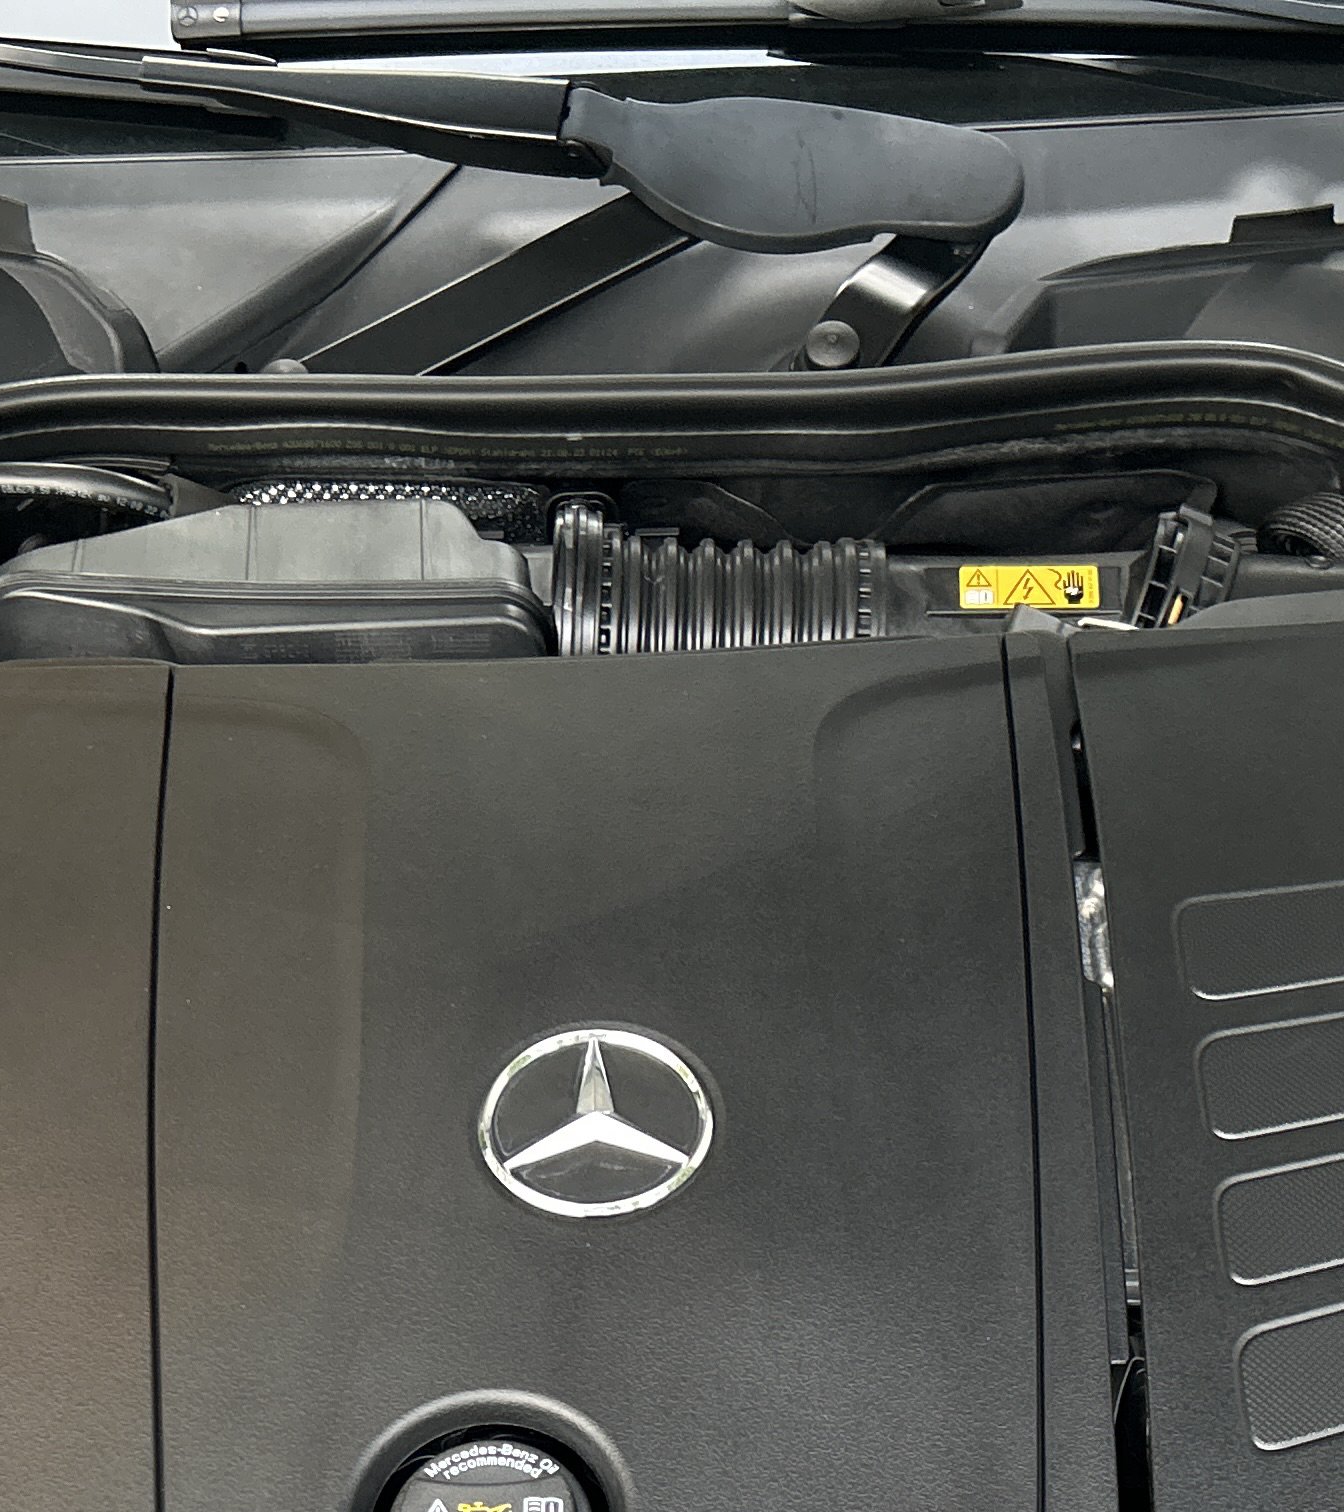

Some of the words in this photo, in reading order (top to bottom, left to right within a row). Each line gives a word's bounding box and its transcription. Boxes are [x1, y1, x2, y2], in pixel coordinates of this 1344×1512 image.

[423, 1443, 539, 1478] Mercedes-Benz
[539, 1458, 560, 1475] Oil
[443, 1456, 543, 1480] recommended
